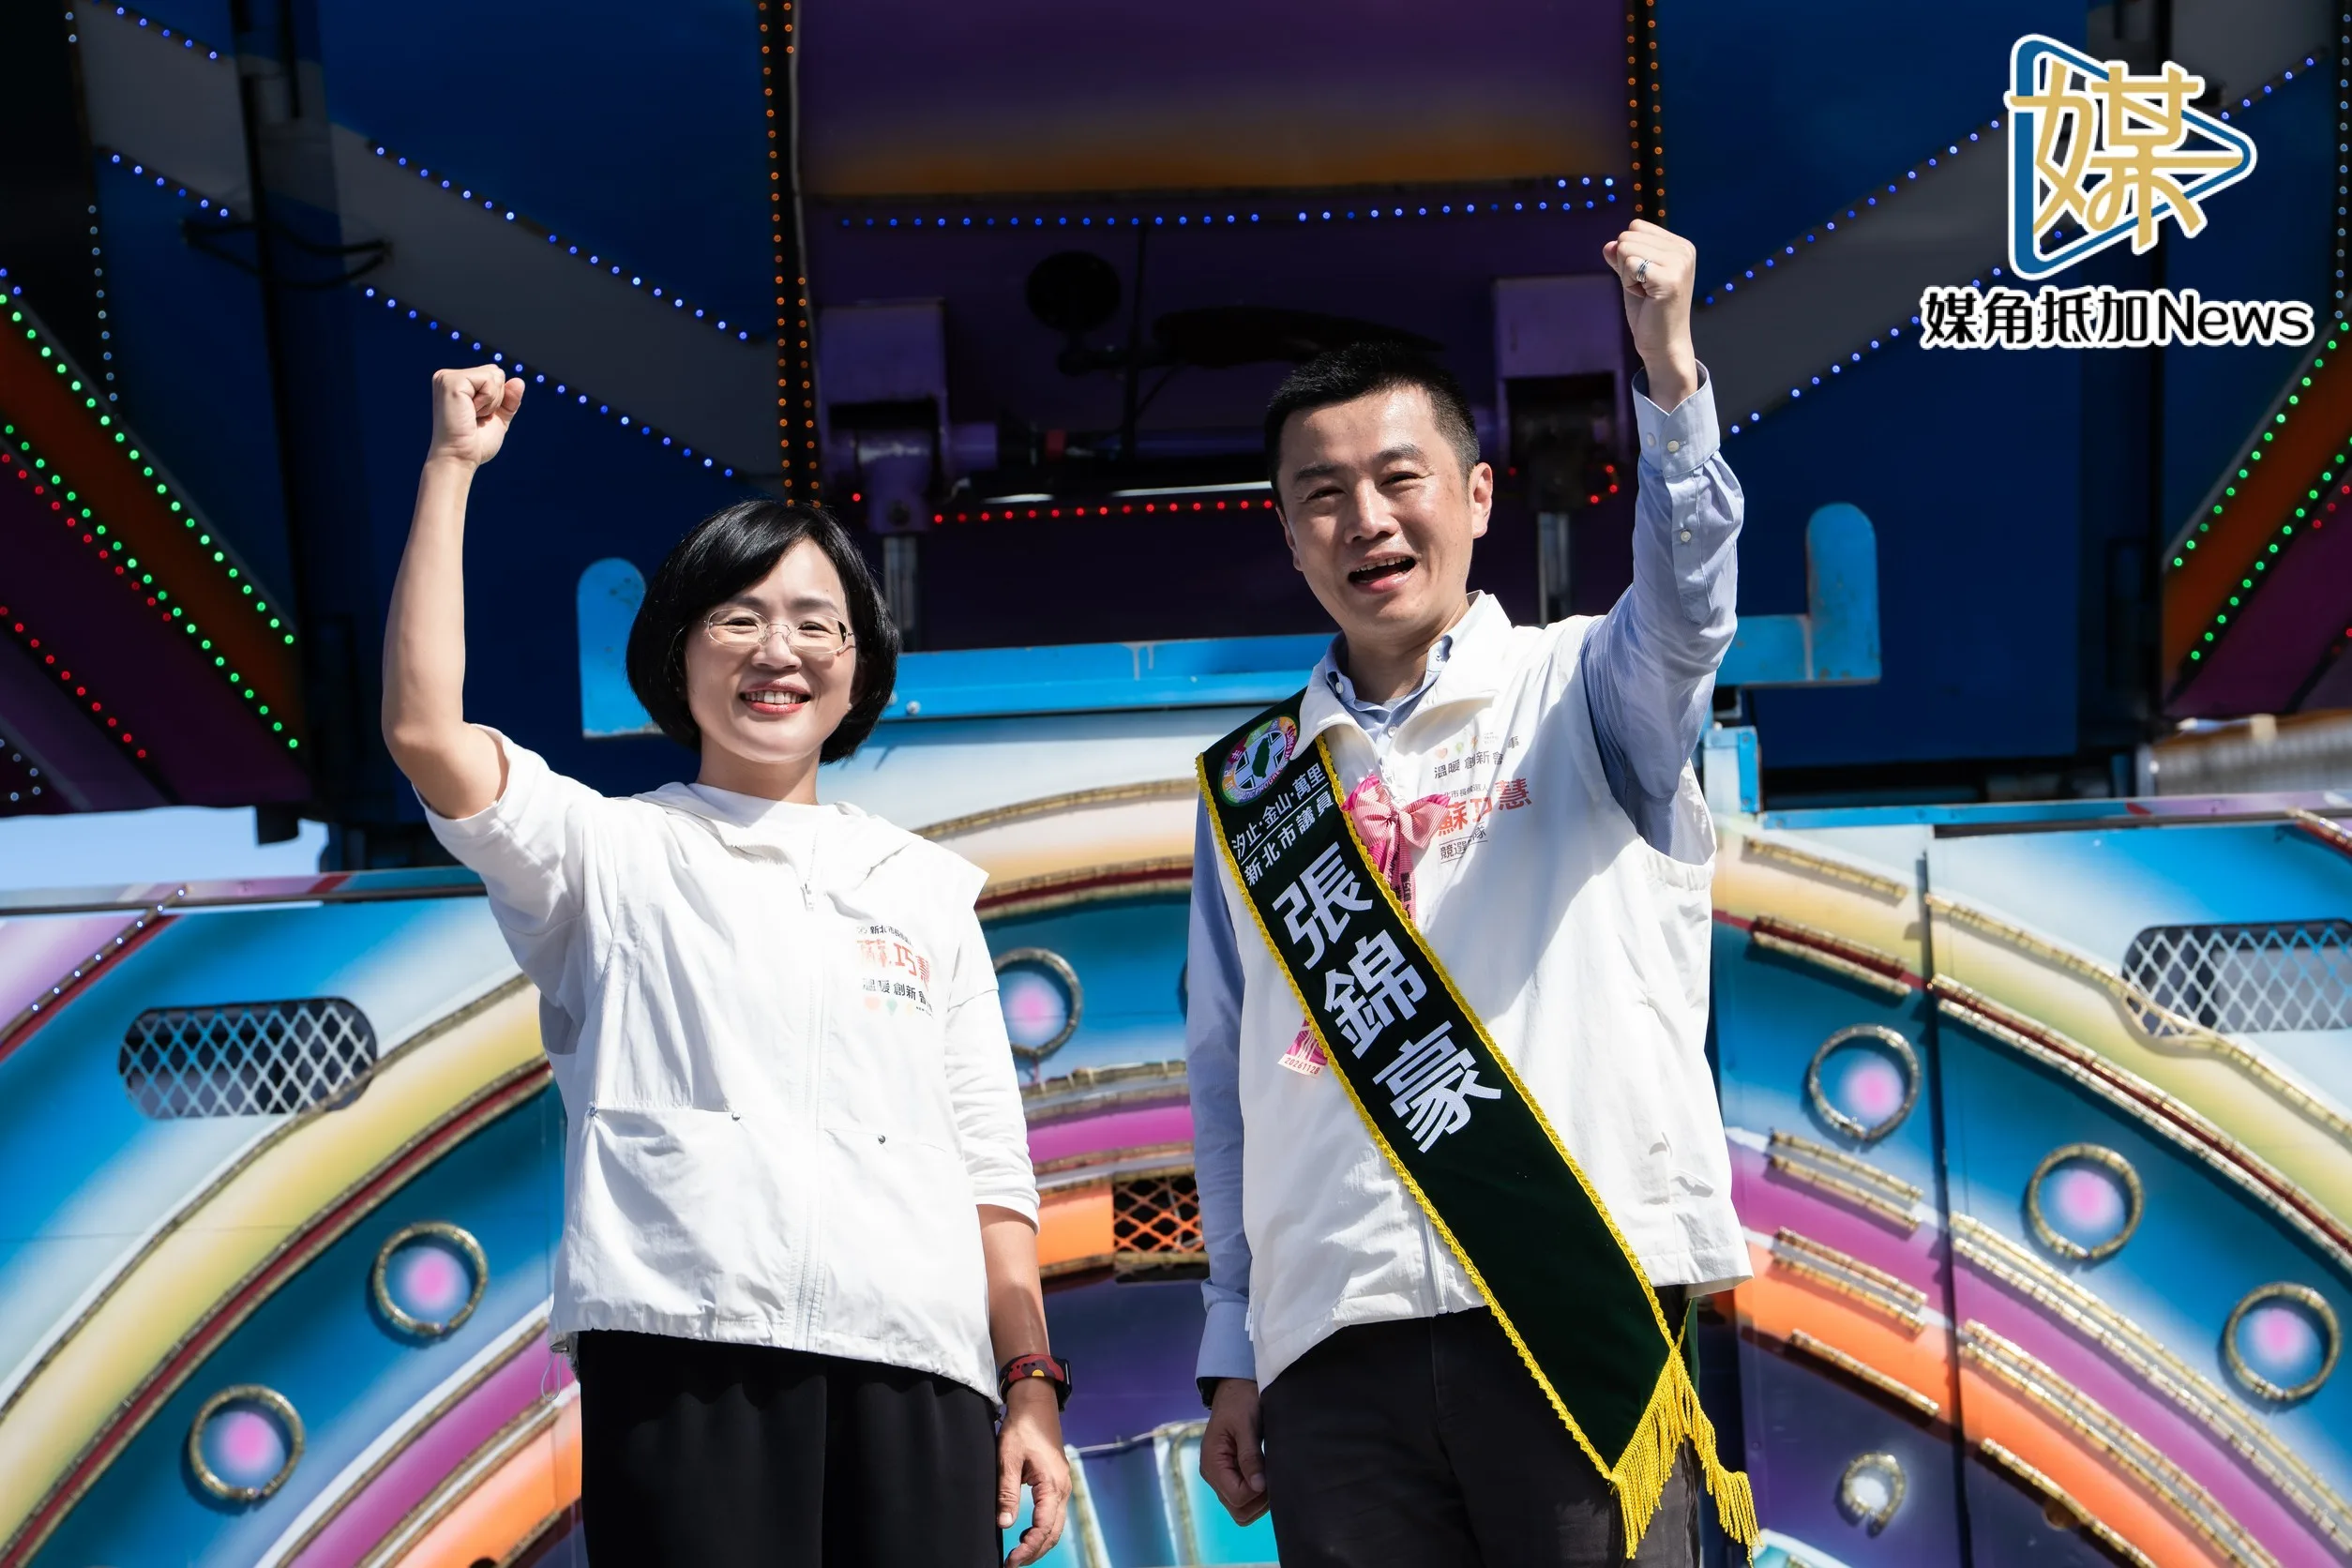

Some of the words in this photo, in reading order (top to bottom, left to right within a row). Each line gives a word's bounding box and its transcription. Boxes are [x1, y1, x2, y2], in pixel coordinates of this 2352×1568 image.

[1434, 759, 1460, 779] 溫暖
[1464, 750, 1490, 769] 創新
[1244, 790, 1334, 886] 新北市議員
[1440, 826, 1487, 860] 競選隊
[893, 983, 916, 1001] 創新
[1272, 841, 1502, 1153] 張錦豪
